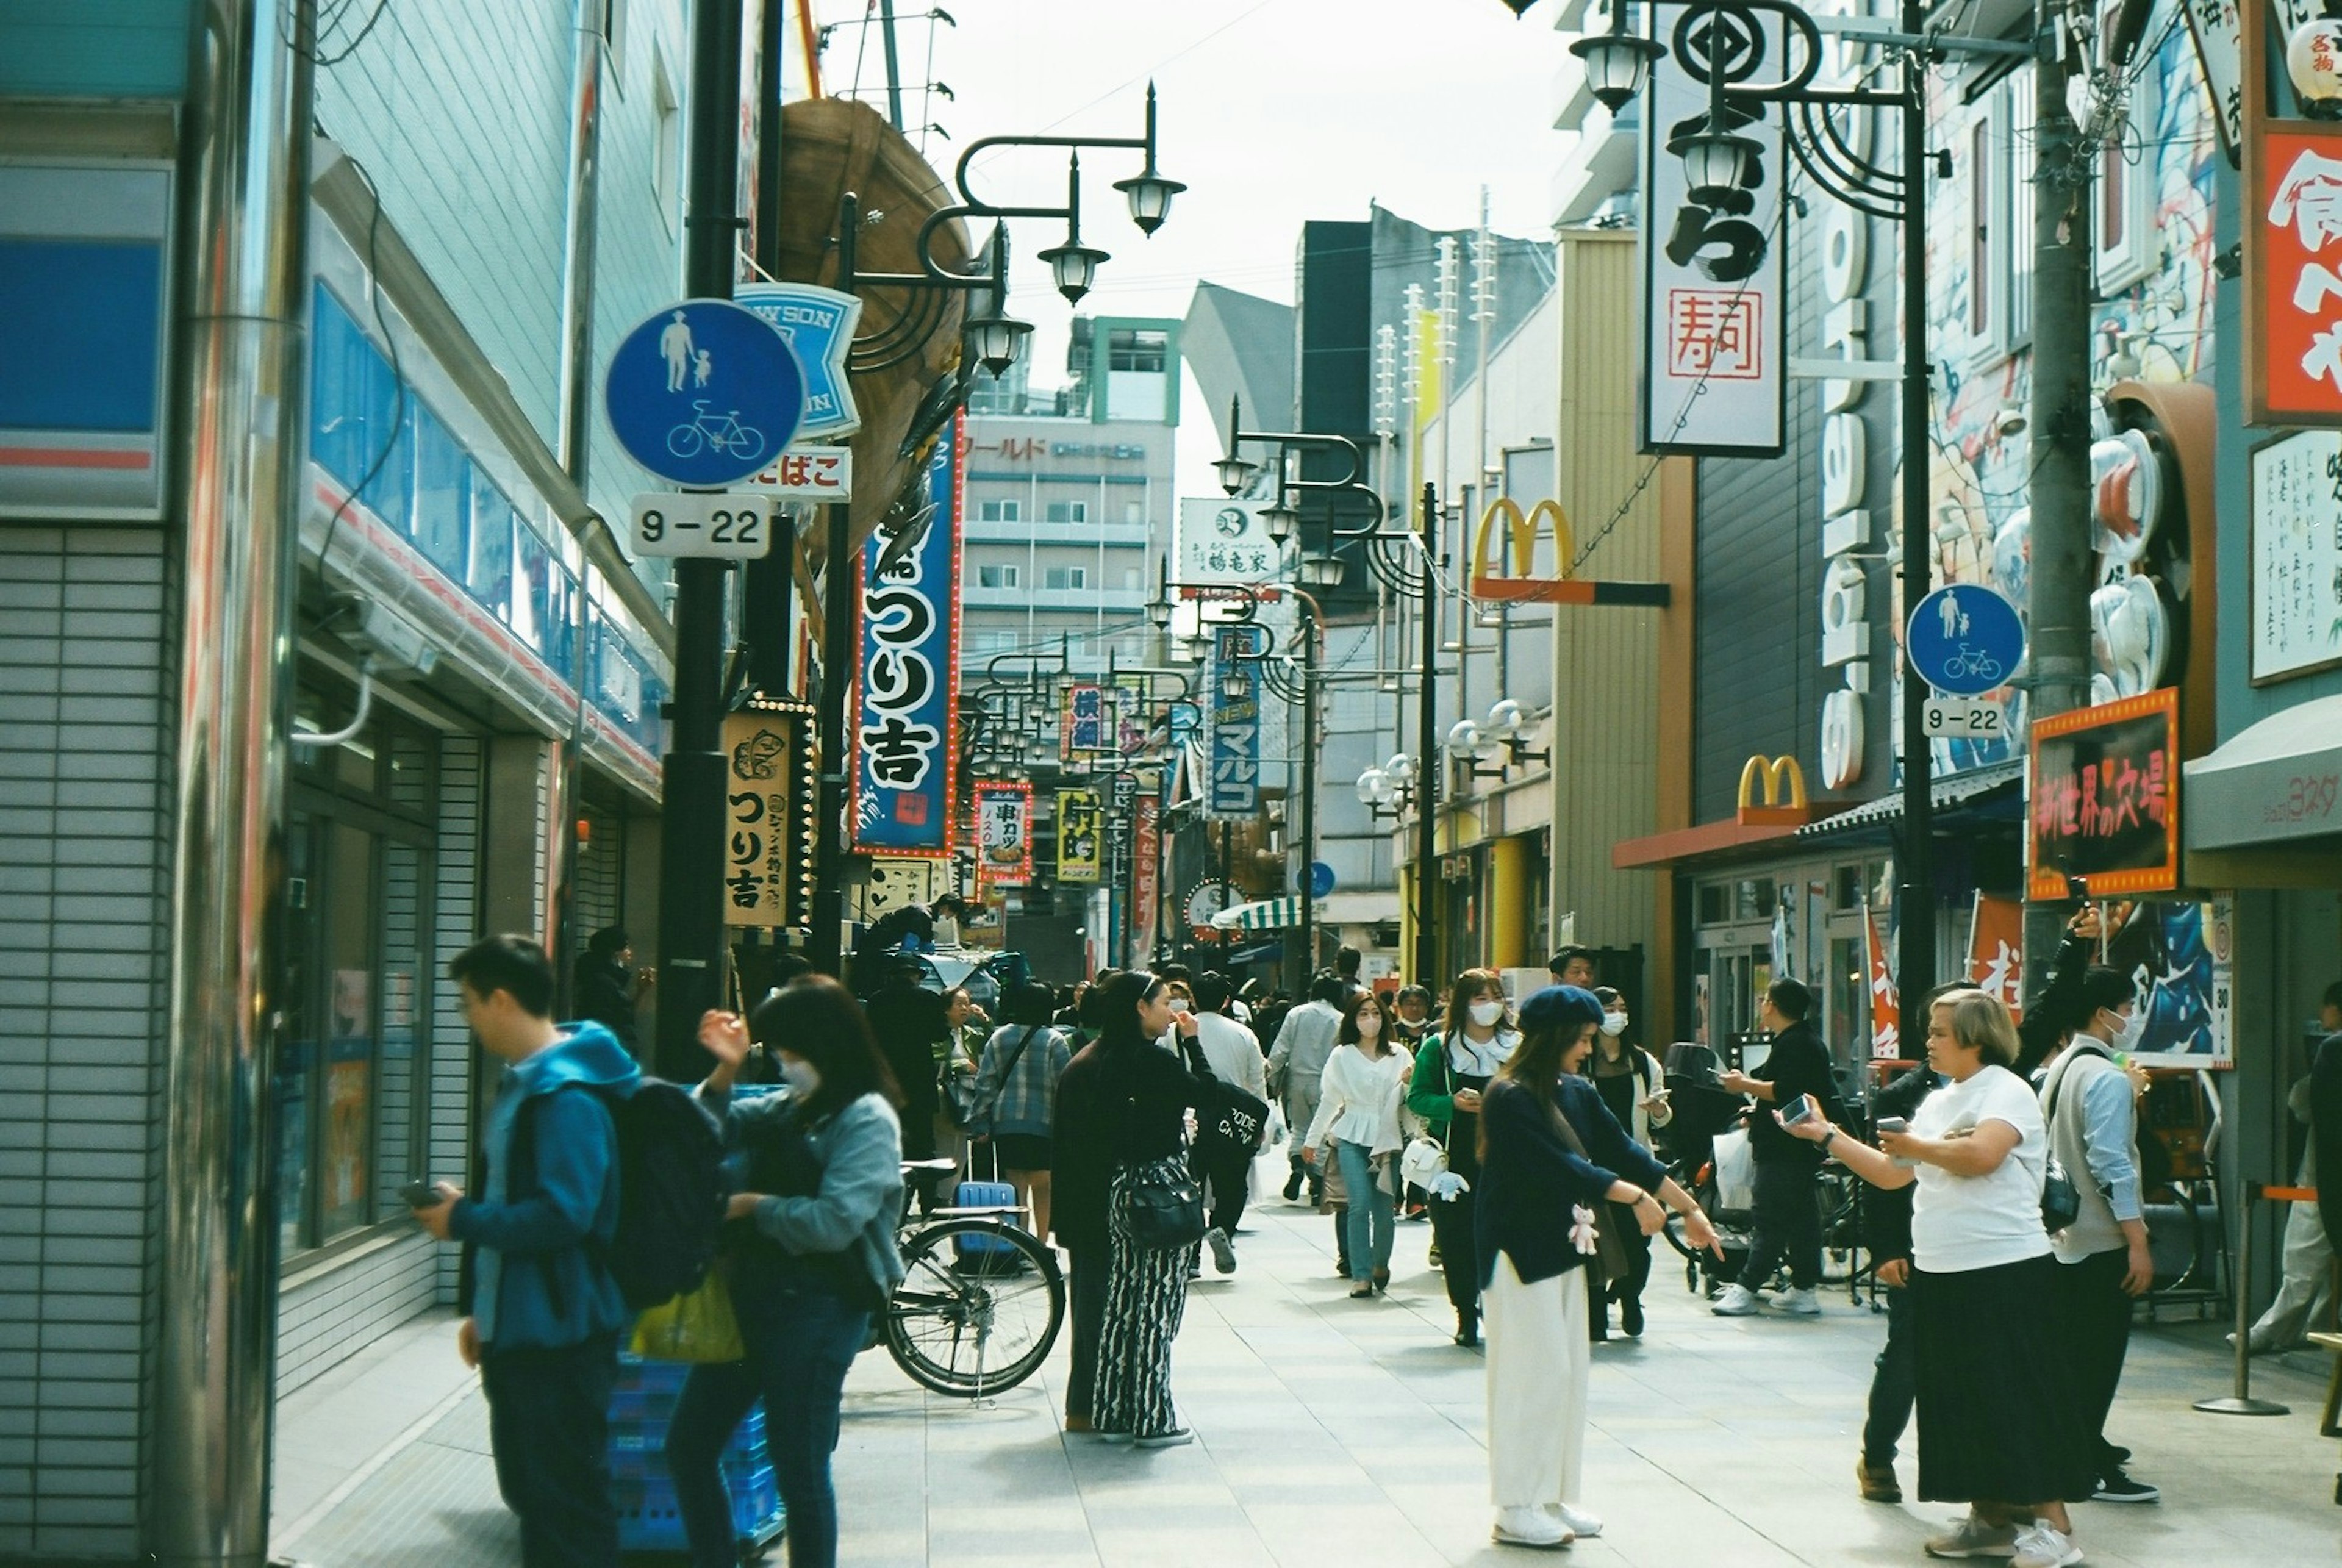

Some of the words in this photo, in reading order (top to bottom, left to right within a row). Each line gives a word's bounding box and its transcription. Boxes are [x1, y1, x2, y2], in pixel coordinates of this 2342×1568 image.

[2310, 34, 2334, 72] 名物
[748, 305, 834, 329] WSON
[1678, 297, 1753, 370] 寿司
[641, 509, 759, 543] 9-22
[1215, 701, 1257, 724] NEW
[1928, 707, 1999, 732] 9-22
[1215, 724, 1257, 810] マルコ
[983, 810, 992, 843] 120
[995, 803, 1017, 849] 串カツ
[726, 791, 765, 909] つり吉
